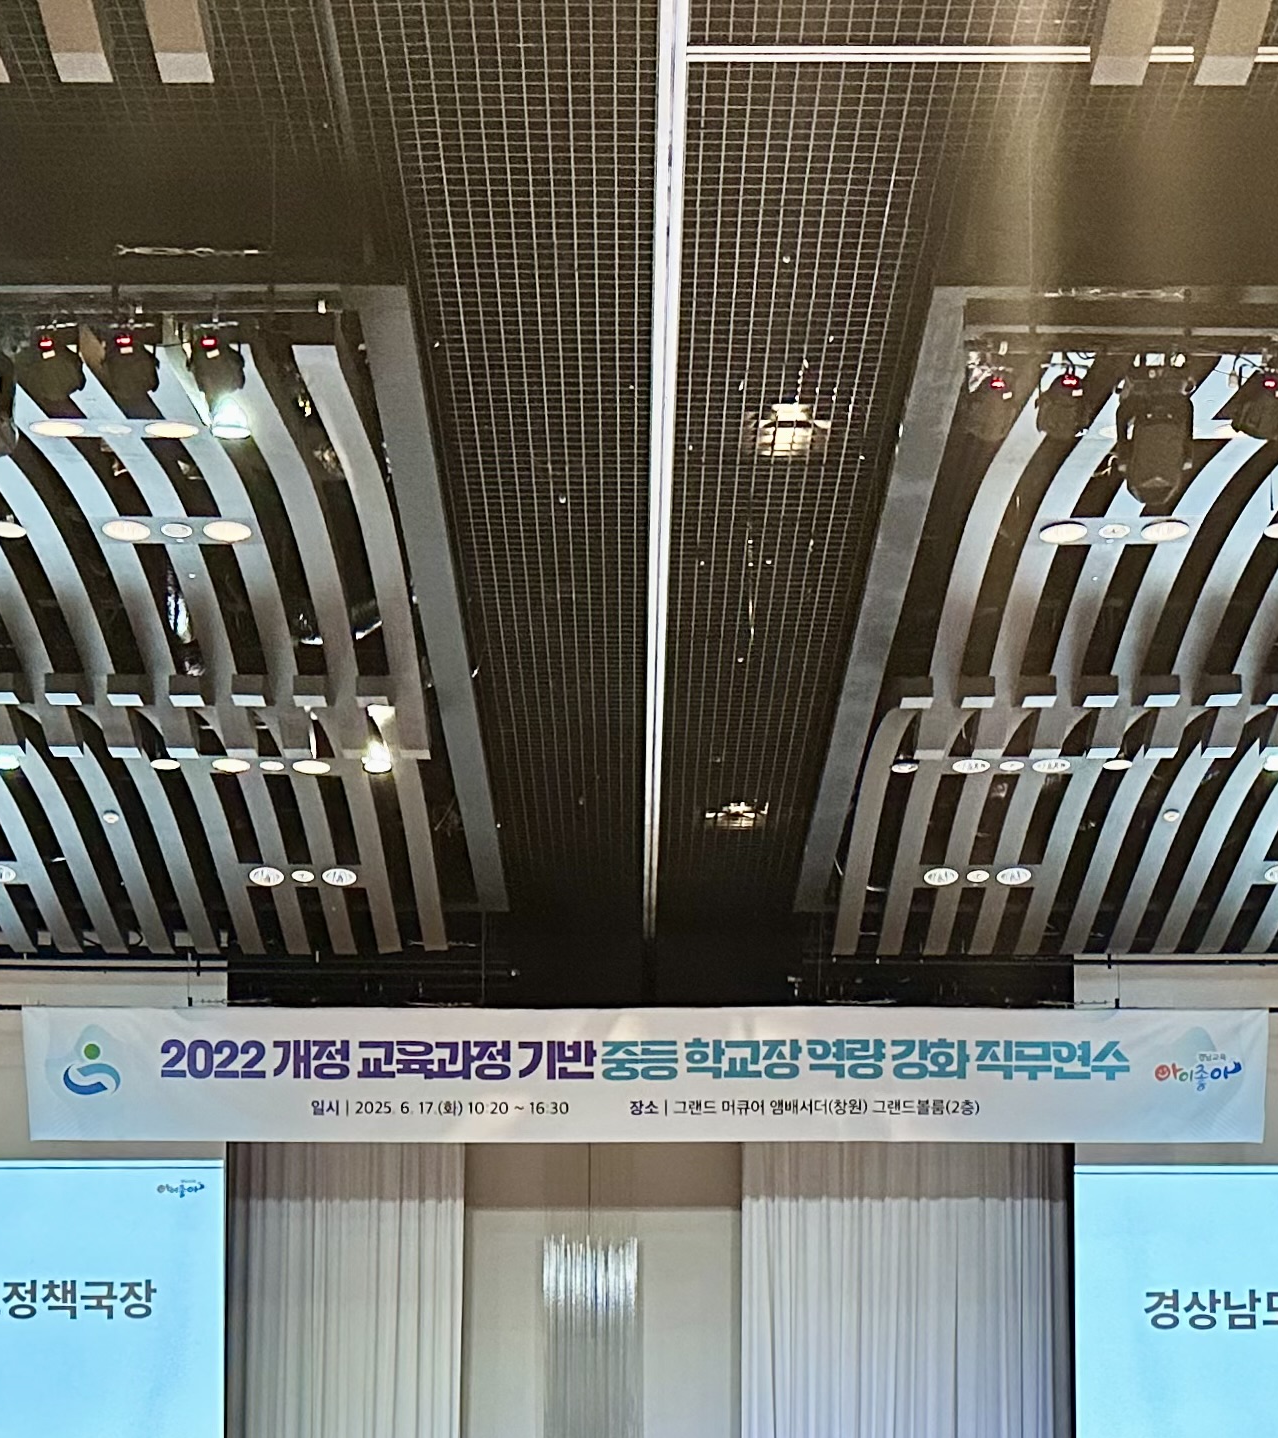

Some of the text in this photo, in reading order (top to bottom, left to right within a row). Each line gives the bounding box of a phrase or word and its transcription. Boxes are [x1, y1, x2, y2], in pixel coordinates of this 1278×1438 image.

[160, 1037, 1131, 1082] 2022 개정 교육과정 기반 중등 학교장 역량 강화 직무연수
[1154, 1060, 1243, 1093] 아이좋아
[310, 1099, 340, 1116] 일시
[419, 1099, 464, 1117] 17.(화)
[468, 1100, 509, 1115] 10:20
[529, 1101, 570, 1116] 16:30
[629, 1099, 981, 1117] 장소 그랜드 머큐어 앰배서더(창원) 그랜드볼룸(2층)
